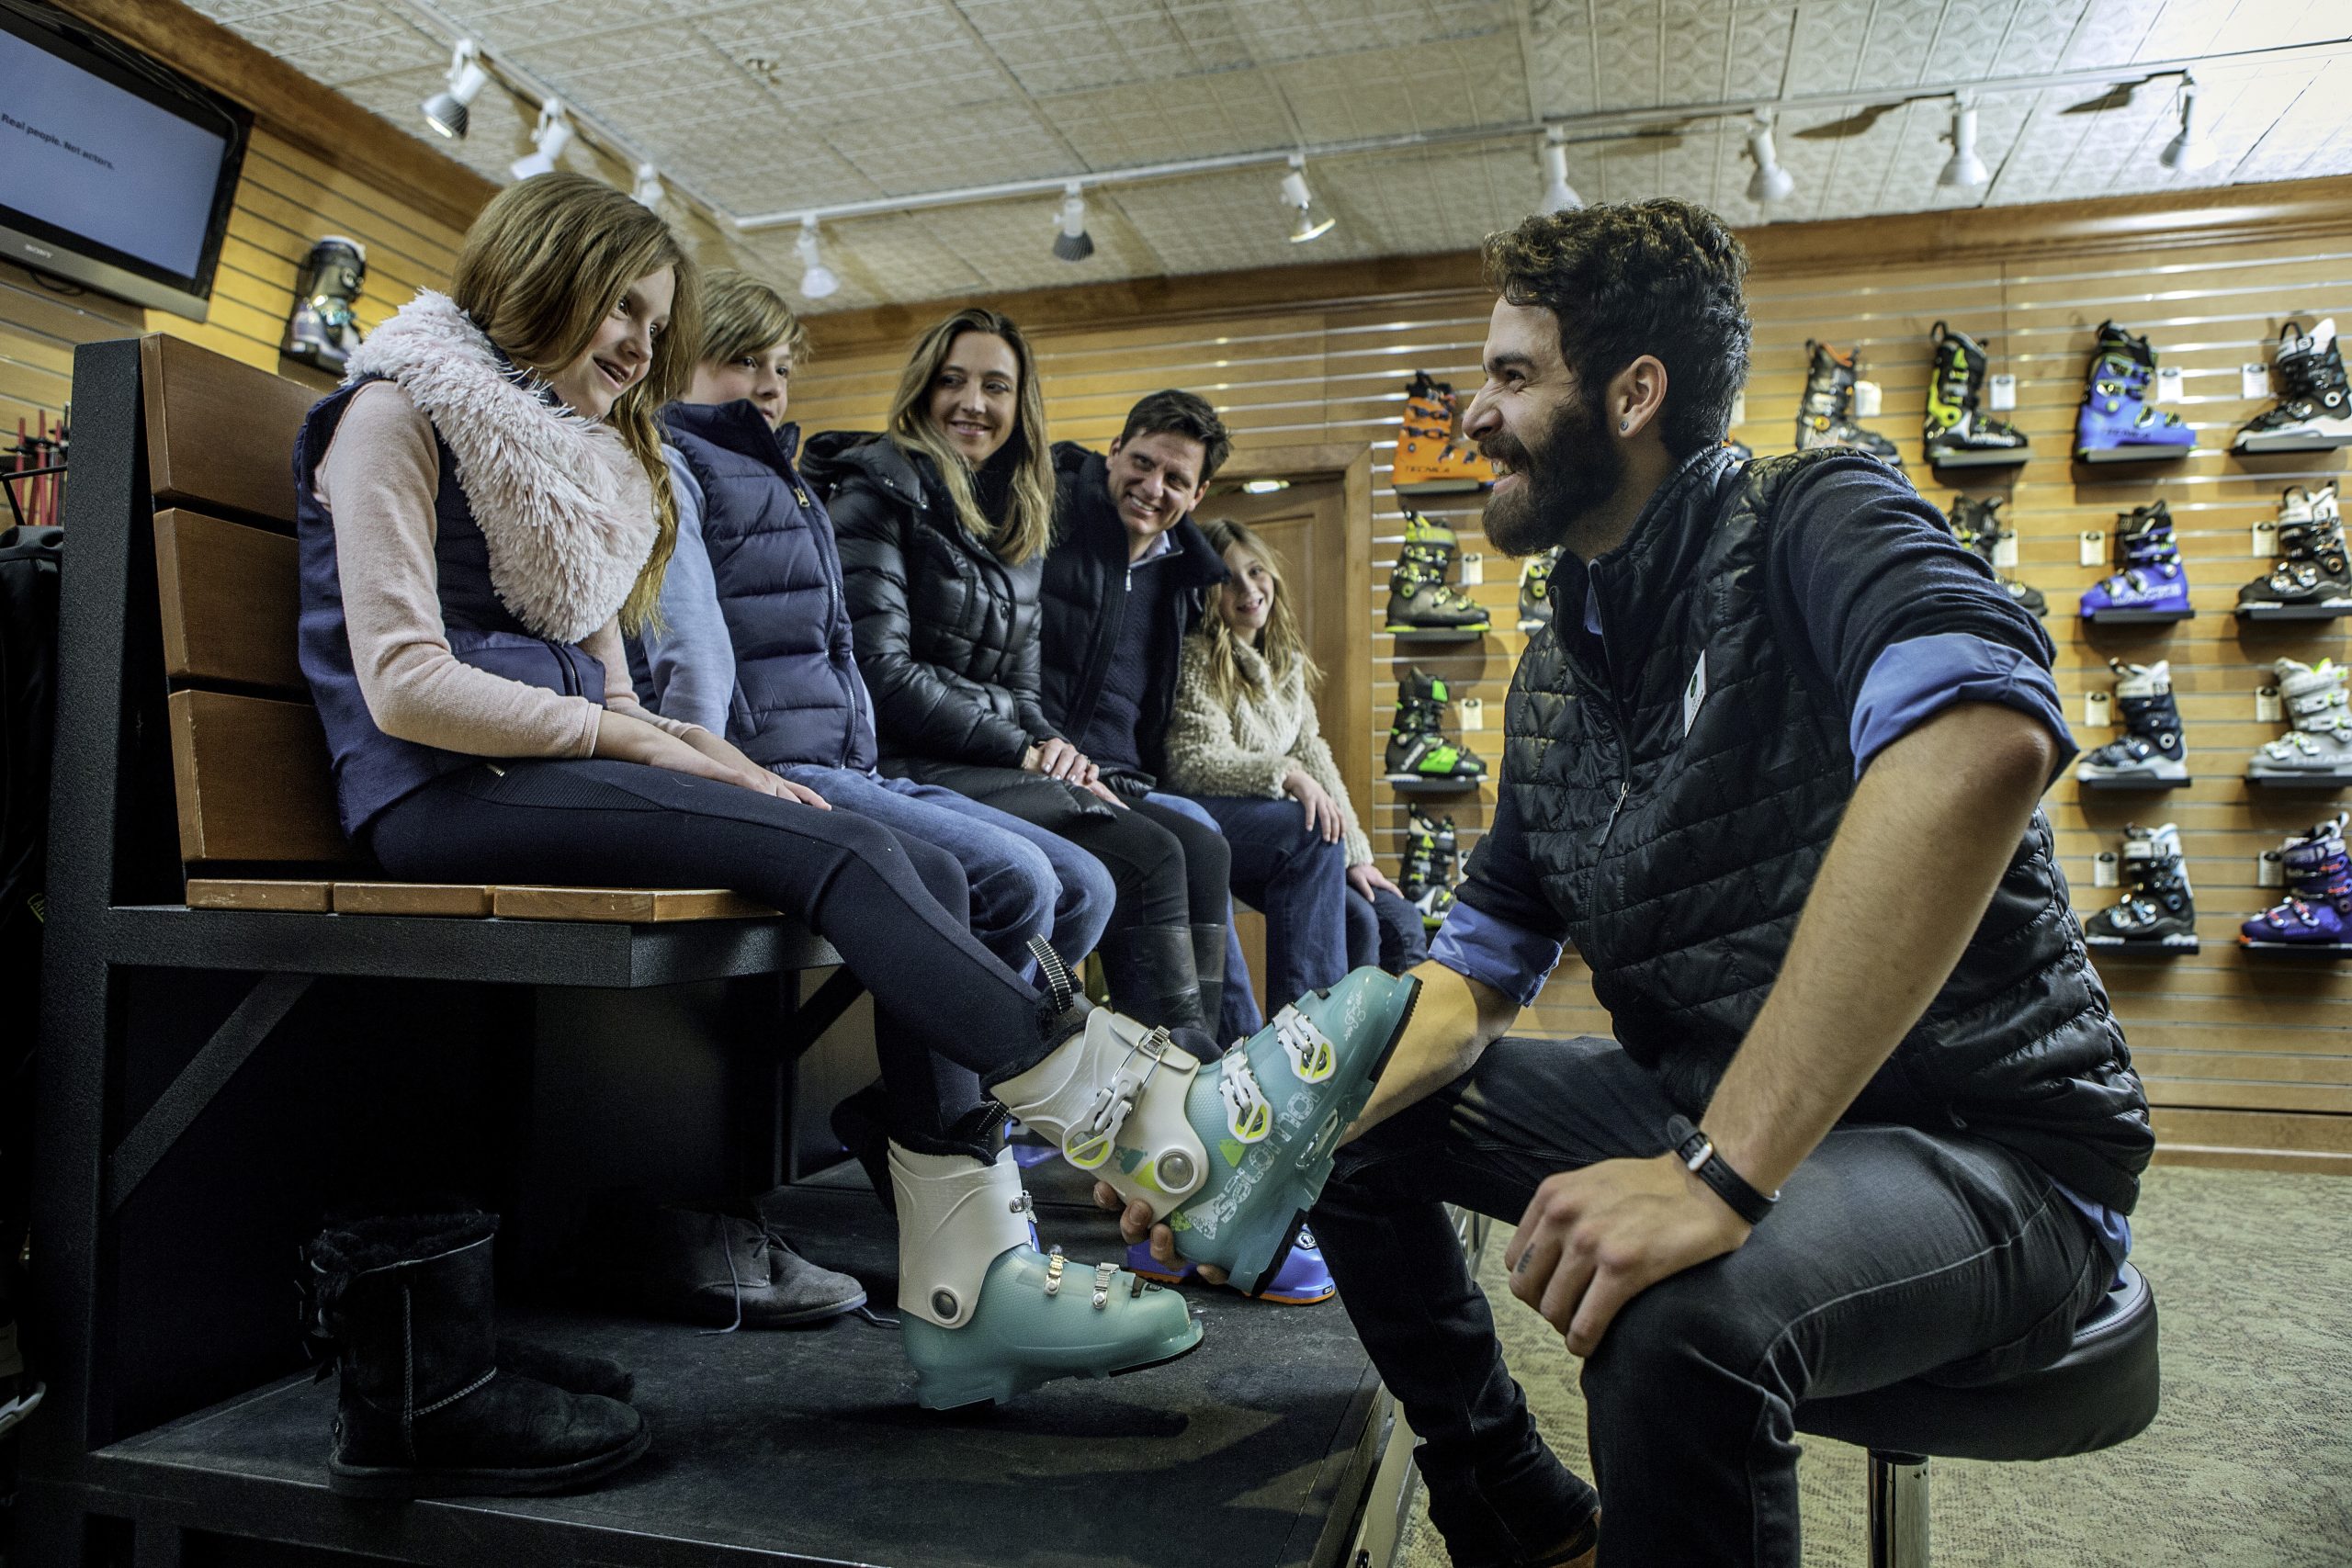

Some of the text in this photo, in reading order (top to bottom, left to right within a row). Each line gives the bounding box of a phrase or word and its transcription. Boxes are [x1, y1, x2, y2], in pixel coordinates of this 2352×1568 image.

[1, 113, 26, 130] Real
[26, 126, 62, 148] people.
[63, 141, 81, 155] Not
